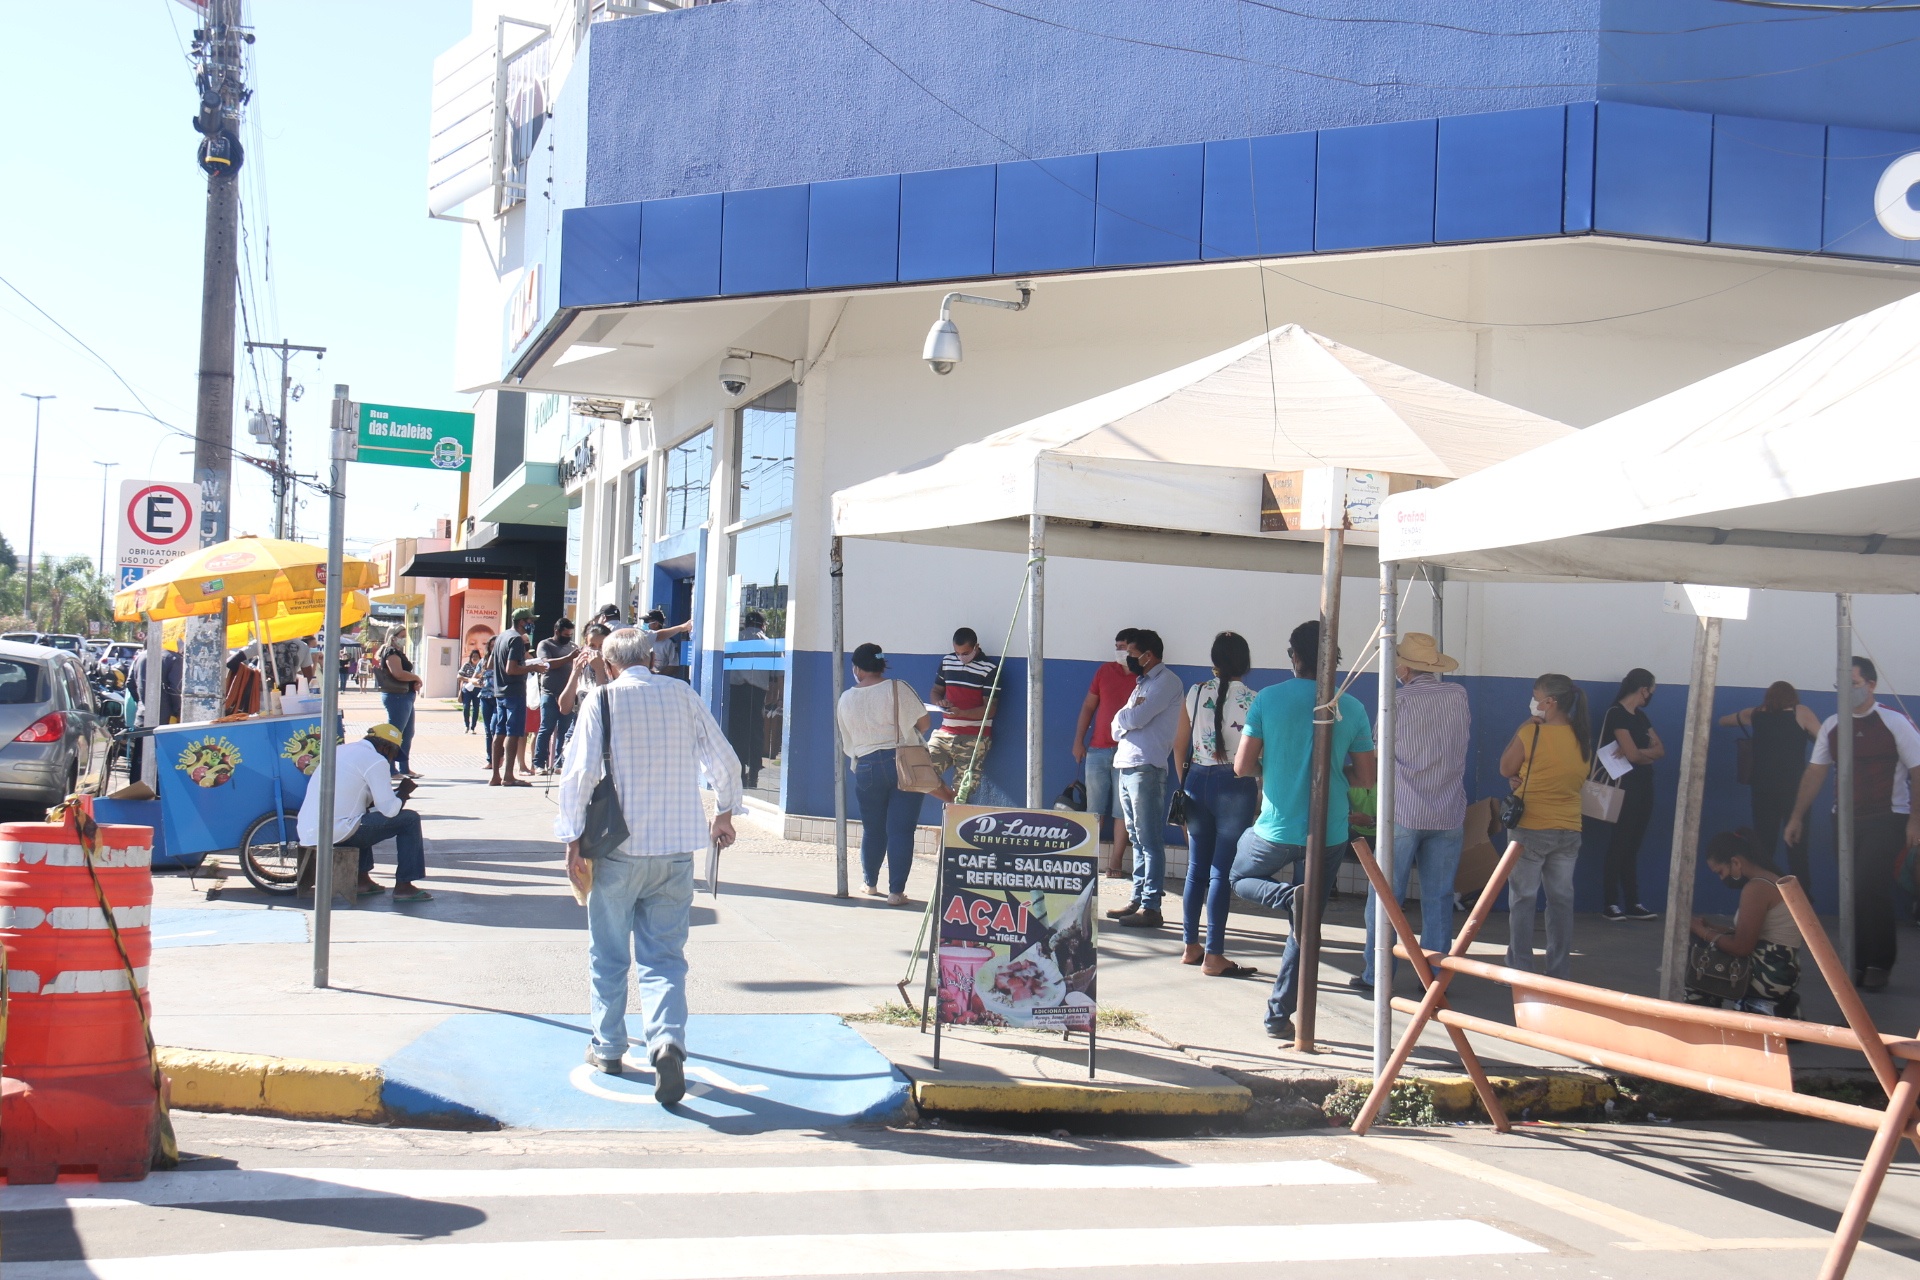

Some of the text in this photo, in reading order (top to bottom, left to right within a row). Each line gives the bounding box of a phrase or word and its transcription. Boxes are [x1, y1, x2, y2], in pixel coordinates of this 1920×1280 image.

[370, 409, 389, 419] Rua
[368, 420, 433, 440] das Azaleias
[146, 496, 174, 534] E
[121, 556, 139, 564] USO
[143, 557, 155, 565] DO
[129, 548, 186, 557] OBRIGATÓRIO
[280, 724, 320, 759] Salada de
[175, 735, 243, 771] Salada de Frutas
[973, 835, 1029, 846] SORVETES
[958, 853, 1091, 875] CAFÉ SALGADOS
[943, 895, 1032, 936] AÇAÍ
[996, 933, 1027, 944] TIGELA
